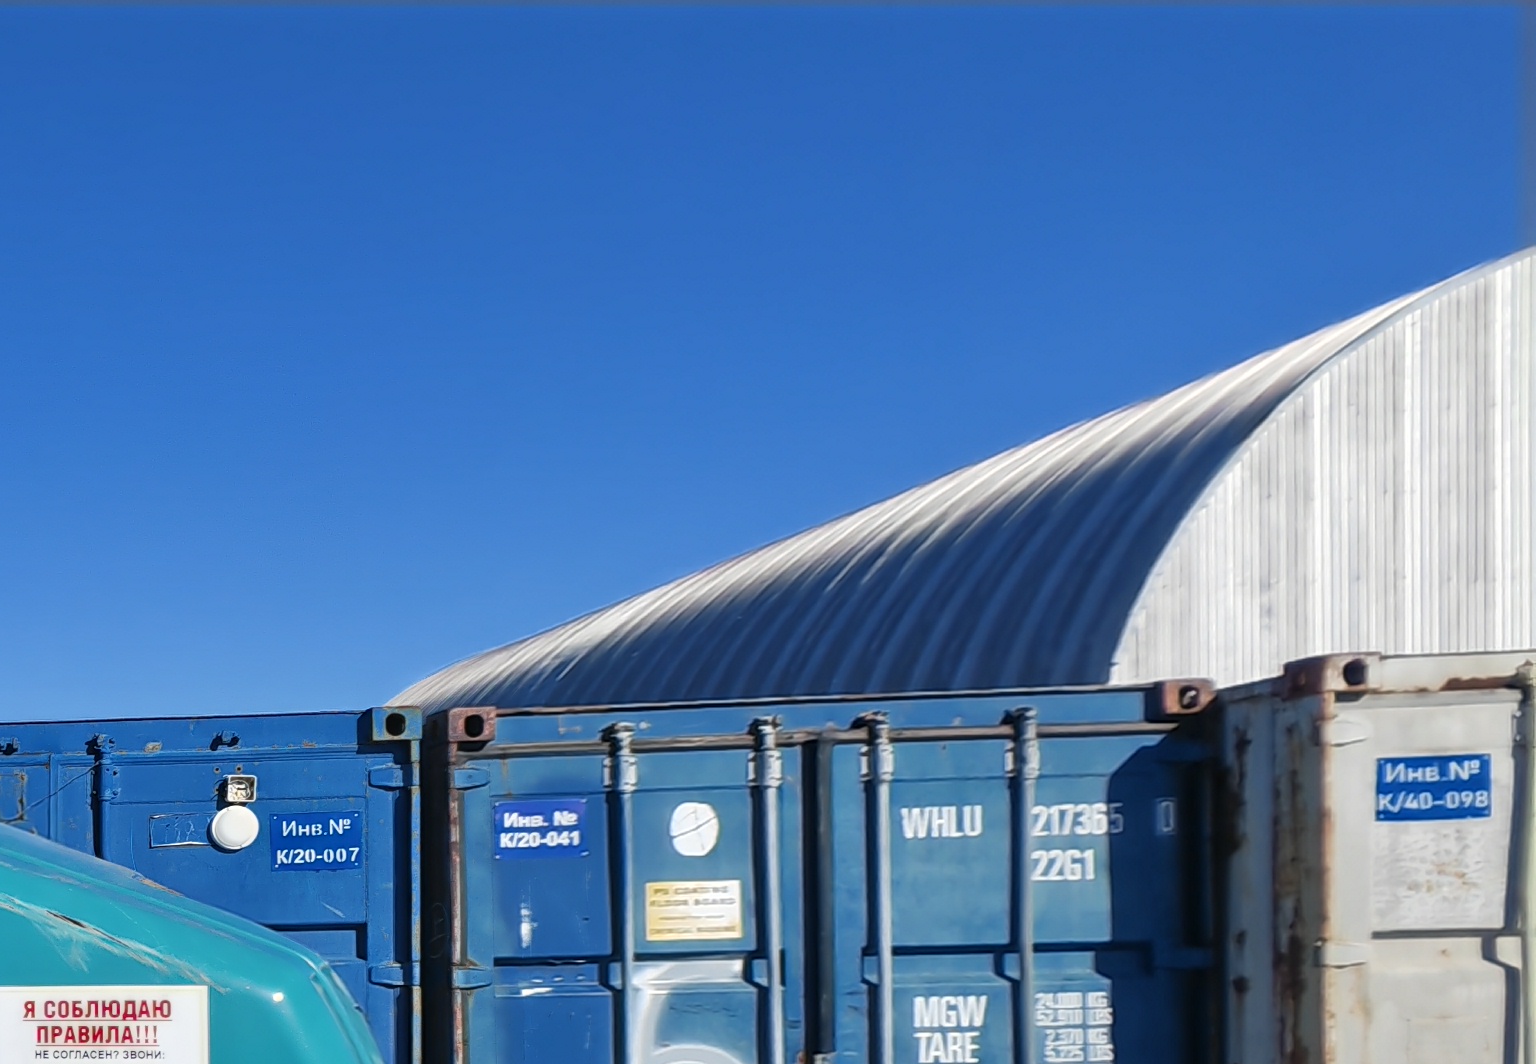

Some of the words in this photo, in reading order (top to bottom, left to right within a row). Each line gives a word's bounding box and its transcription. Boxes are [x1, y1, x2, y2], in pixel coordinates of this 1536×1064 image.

[900, 805, 982, 839] WHLU
[1031, 802, 1124, 837] 217365
[500, 830, 581, 849] К/20-041
[276, 847, 360, 865] К/20-007
[23, 1000, 36, 1019] Я
[44, 1000, 172, 1021] СОБЛЮДАЮ
[913, 994, 988, 1028] MGW
[36, 1025, 159, 1044] ПРАВИЛА!!!
[35, 1050, 50, 1060] НЕ
[53, 1050, 119, 1060] СОГЛАСЕН?
[123, 1050, 166, 1060] ЗВОНИ:
[913, 1031, 981, 1064] TARE
